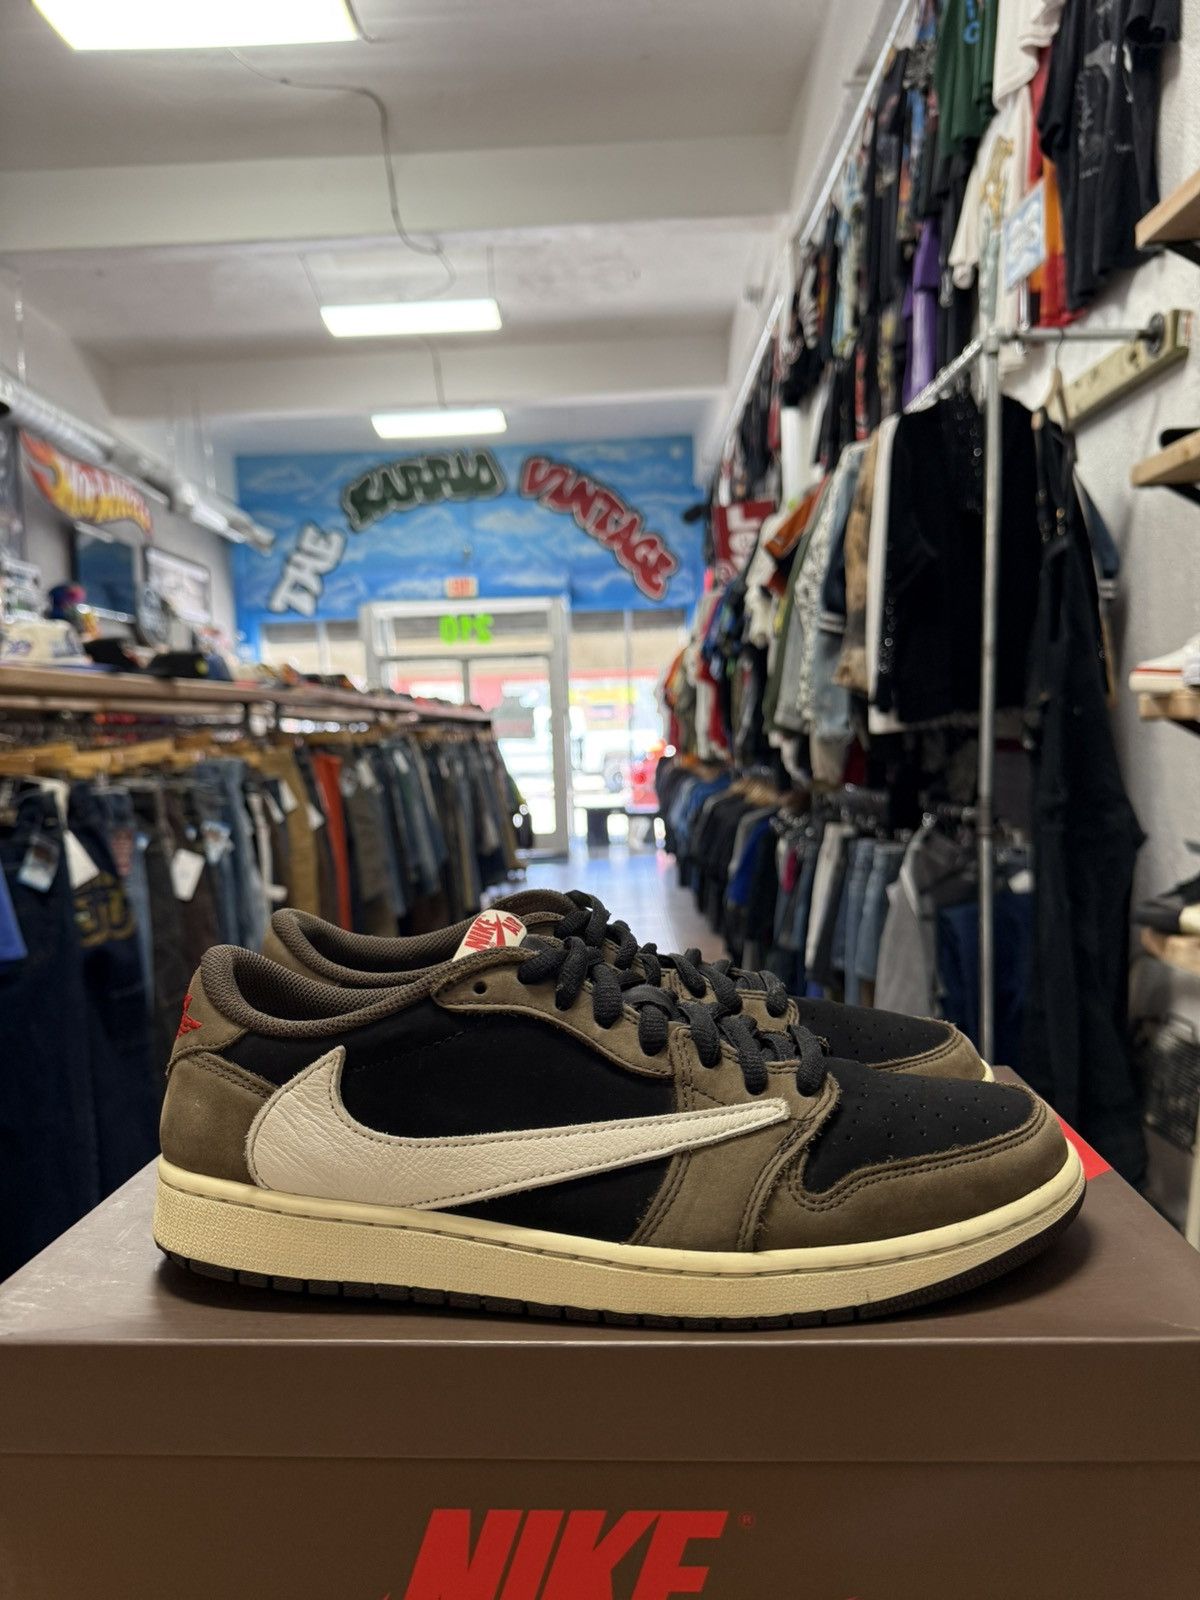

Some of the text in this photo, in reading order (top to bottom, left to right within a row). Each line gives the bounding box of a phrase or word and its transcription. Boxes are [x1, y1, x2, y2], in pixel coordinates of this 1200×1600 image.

[269, 524, 346, 616] THE
[521, 457, 678, 600] VINTAGE
[464, 916, 497, 952] NIKE
[403, 1509, 729, 1600] NIKE
